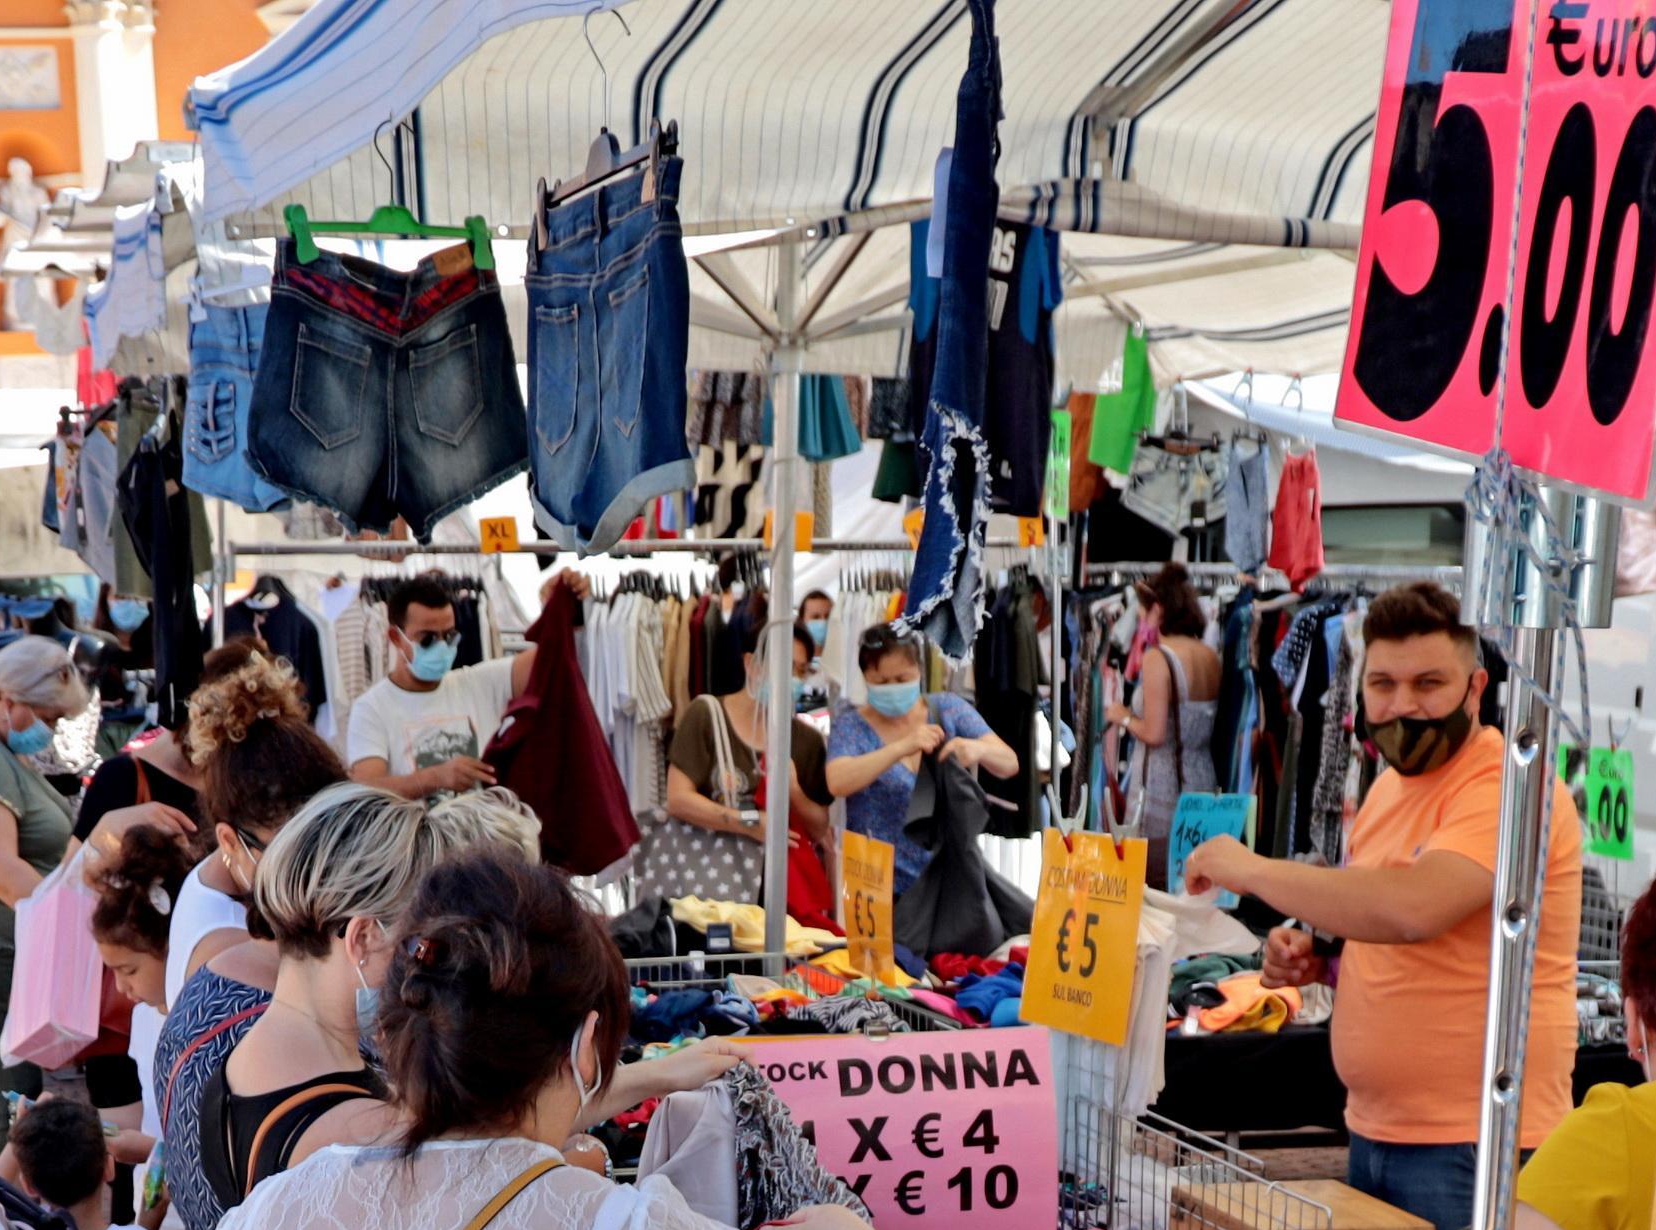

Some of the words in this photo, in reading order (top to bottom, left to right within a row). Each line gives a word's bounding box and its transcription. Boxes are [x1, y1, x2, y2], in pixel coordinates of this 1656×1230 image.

[988, 226, 1017, 274] AS
[488, 522, 511, 539] XL
[1088, 870, 1127, 897] DONNA
[854, 889, 864, 935] €
[866, 895, 876, 938] 5
[1057, 908, 1076, 973] €
[1079, 913, 1100, 979] 5
[1053, 982, 1065, 1000] SUL
[1067, 986, 1093, 1007] BANCO
[759, 1060, 828, 1083] OCK
[837, 1049, 1041, 1097] DONNA
[846, 1115, 893, 1164] X
[911, 1112, 945, 1159] €
[961, 1109, 1001, 1155] 4
[894, 1170, 927, 1216] €
[947, 1164, 1020, 1212] 10
